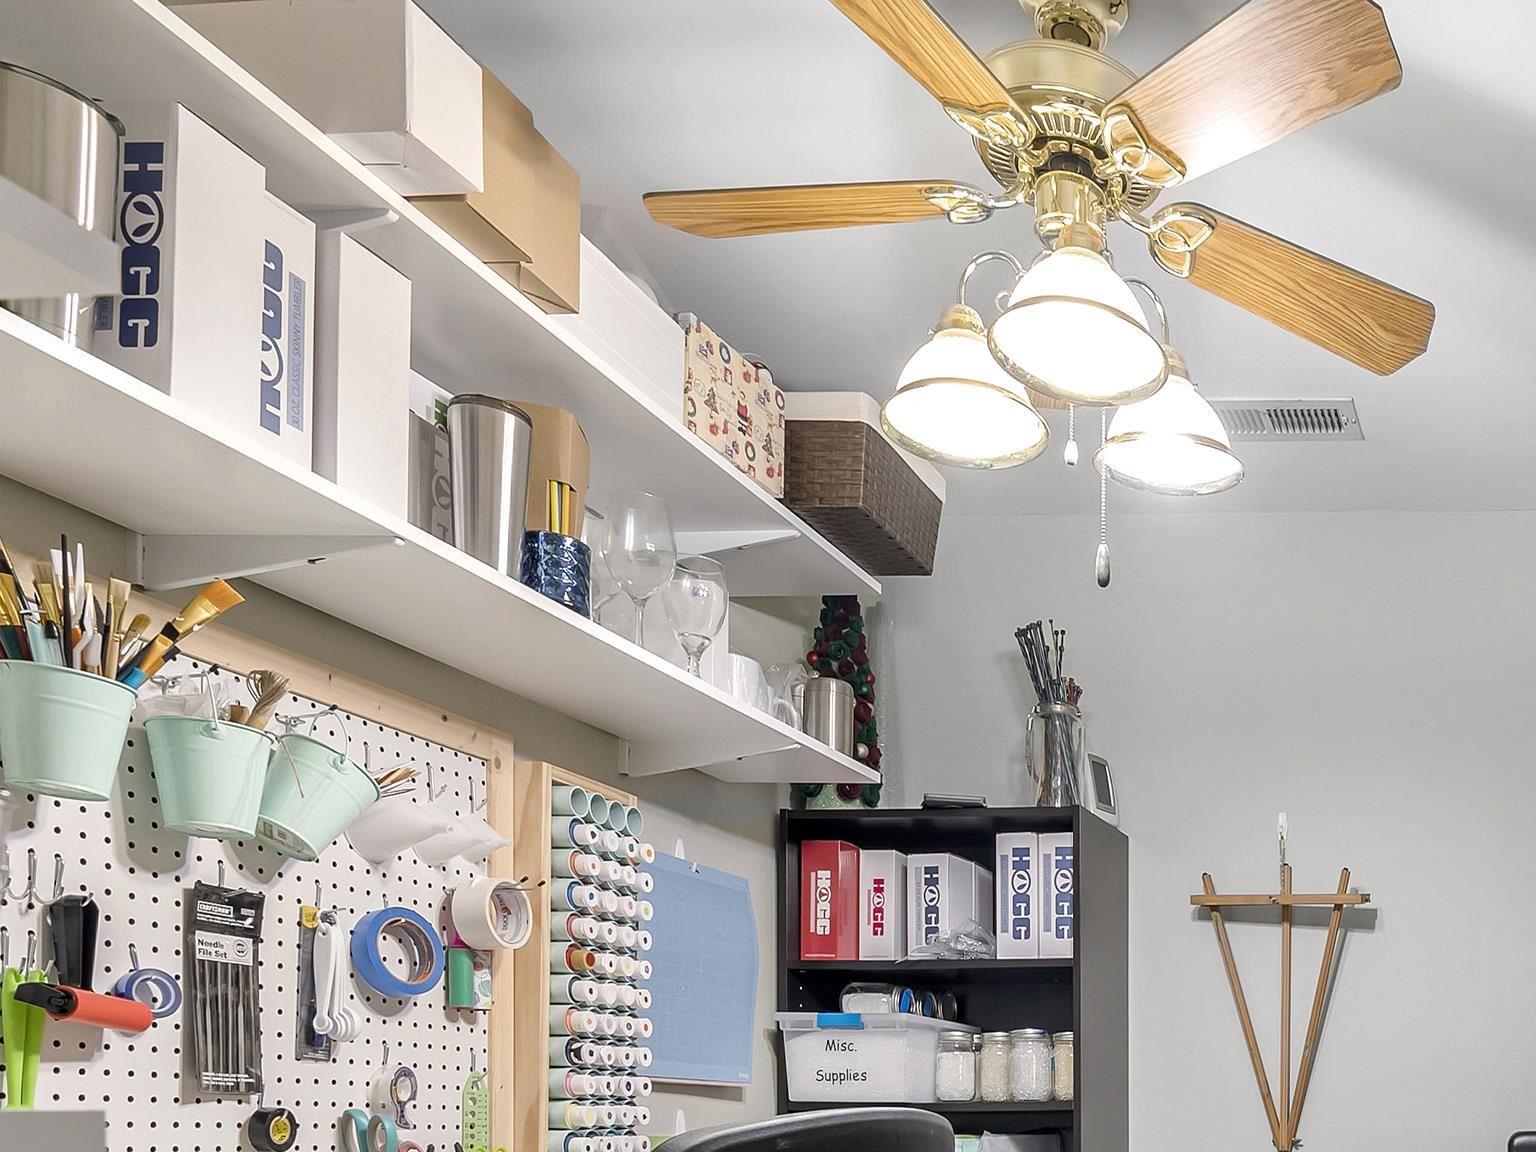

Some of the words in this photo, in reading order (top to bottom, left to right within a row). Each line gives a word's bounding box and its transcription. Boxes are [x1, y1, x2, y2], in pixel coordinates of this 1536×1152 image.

[119, 142, 164, 348] HOGG
[816, 870, 831, 936] HOGG
[872, 878, 885, 936] HOGG
[1011, 847, 1031, 940] HOGG
[198, 938, 224, 950] Needle
[198, 949, 213, 957] File
[215, 950, 228, 959] Set
[825, 1039, 858, 1052] Misc.
[815, 1068, 868, 1086] Supplies
